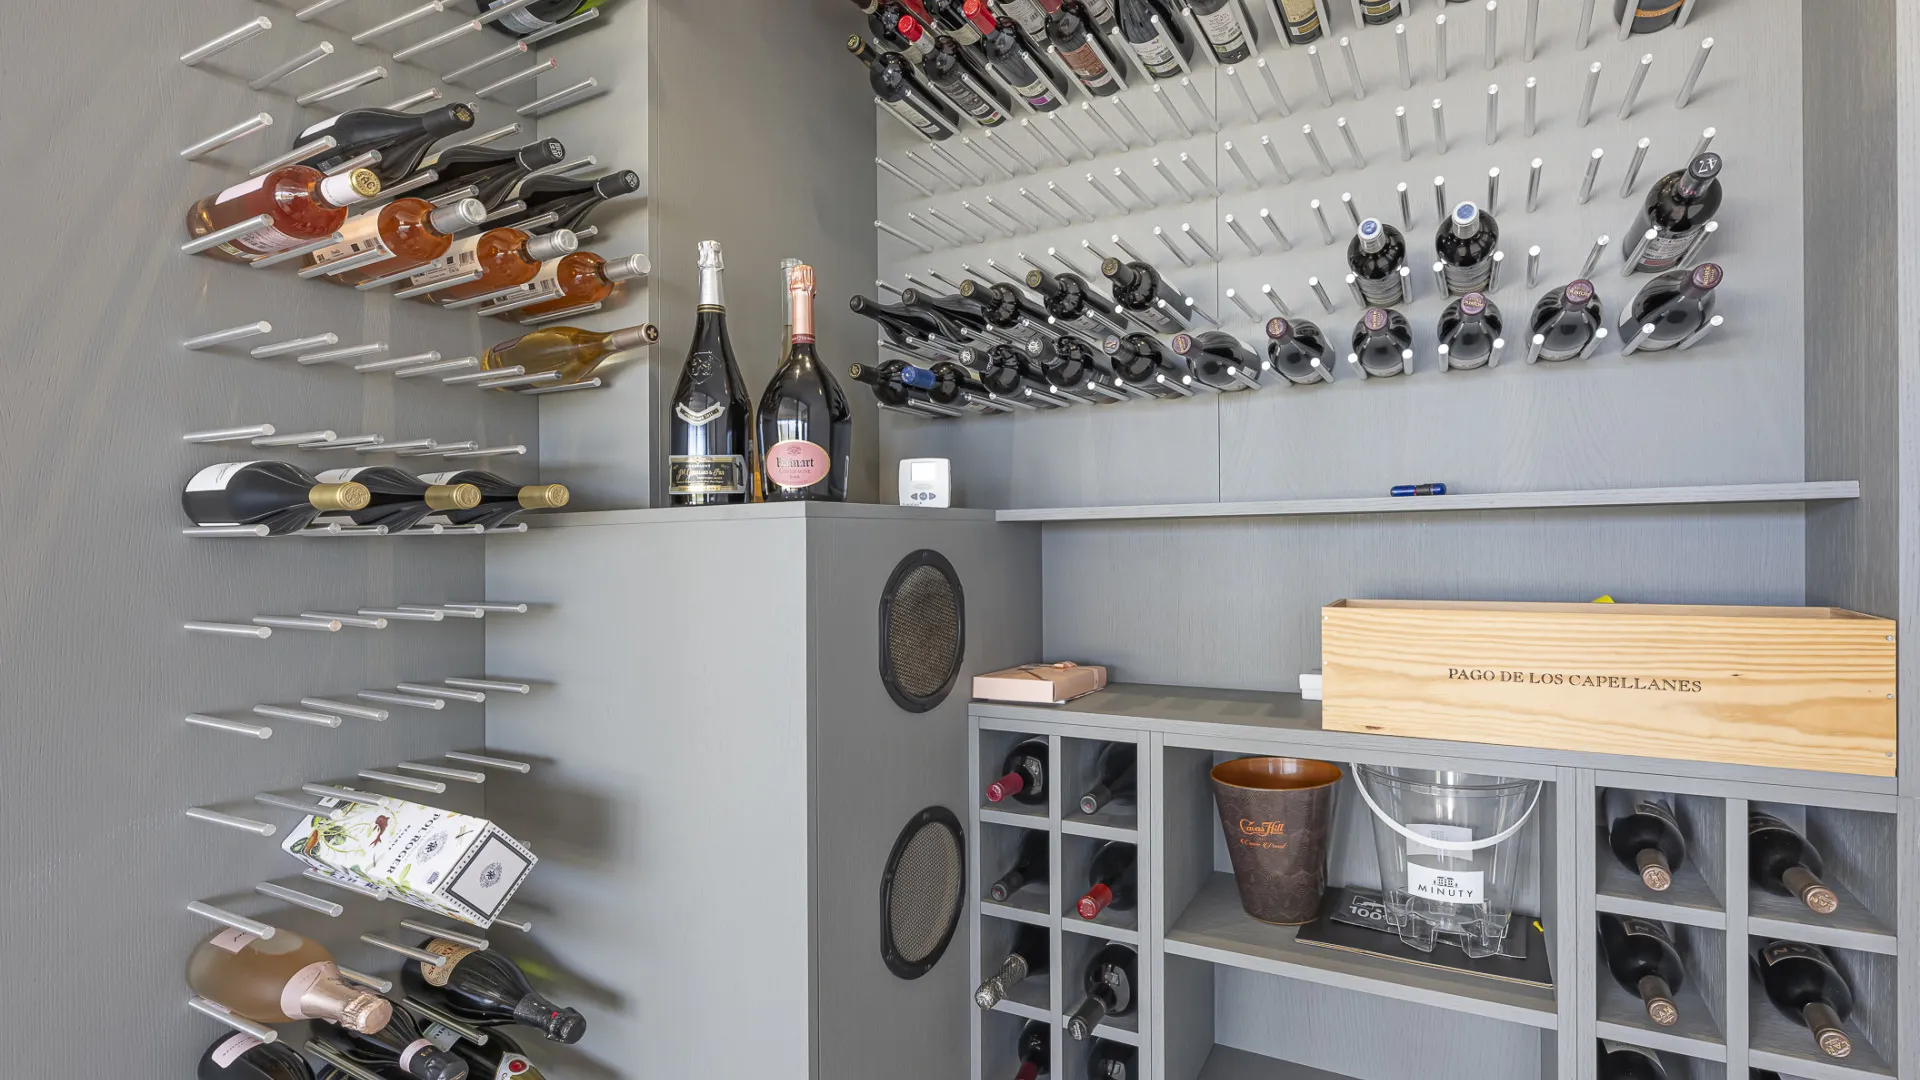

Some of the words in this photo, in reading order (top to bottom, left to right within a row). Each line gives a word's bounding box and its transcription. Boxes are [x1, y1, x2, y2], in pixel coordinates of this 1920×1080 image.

[1448, 668, 1496, 682] PAGO
[1499, 670, 1524, 683] DE
[1529, 672, 1563, 685] LOS
[1568, 674, 1702, 693] CAPELLANES
[418, 813, 441, 834] POL
[1261, 820, 1285, 836] Hill
[387, 835, 422, 874] ROGER
[1417, 883, 1474, 898] MINUTY
[1349, 905, 1386, 920] 100
